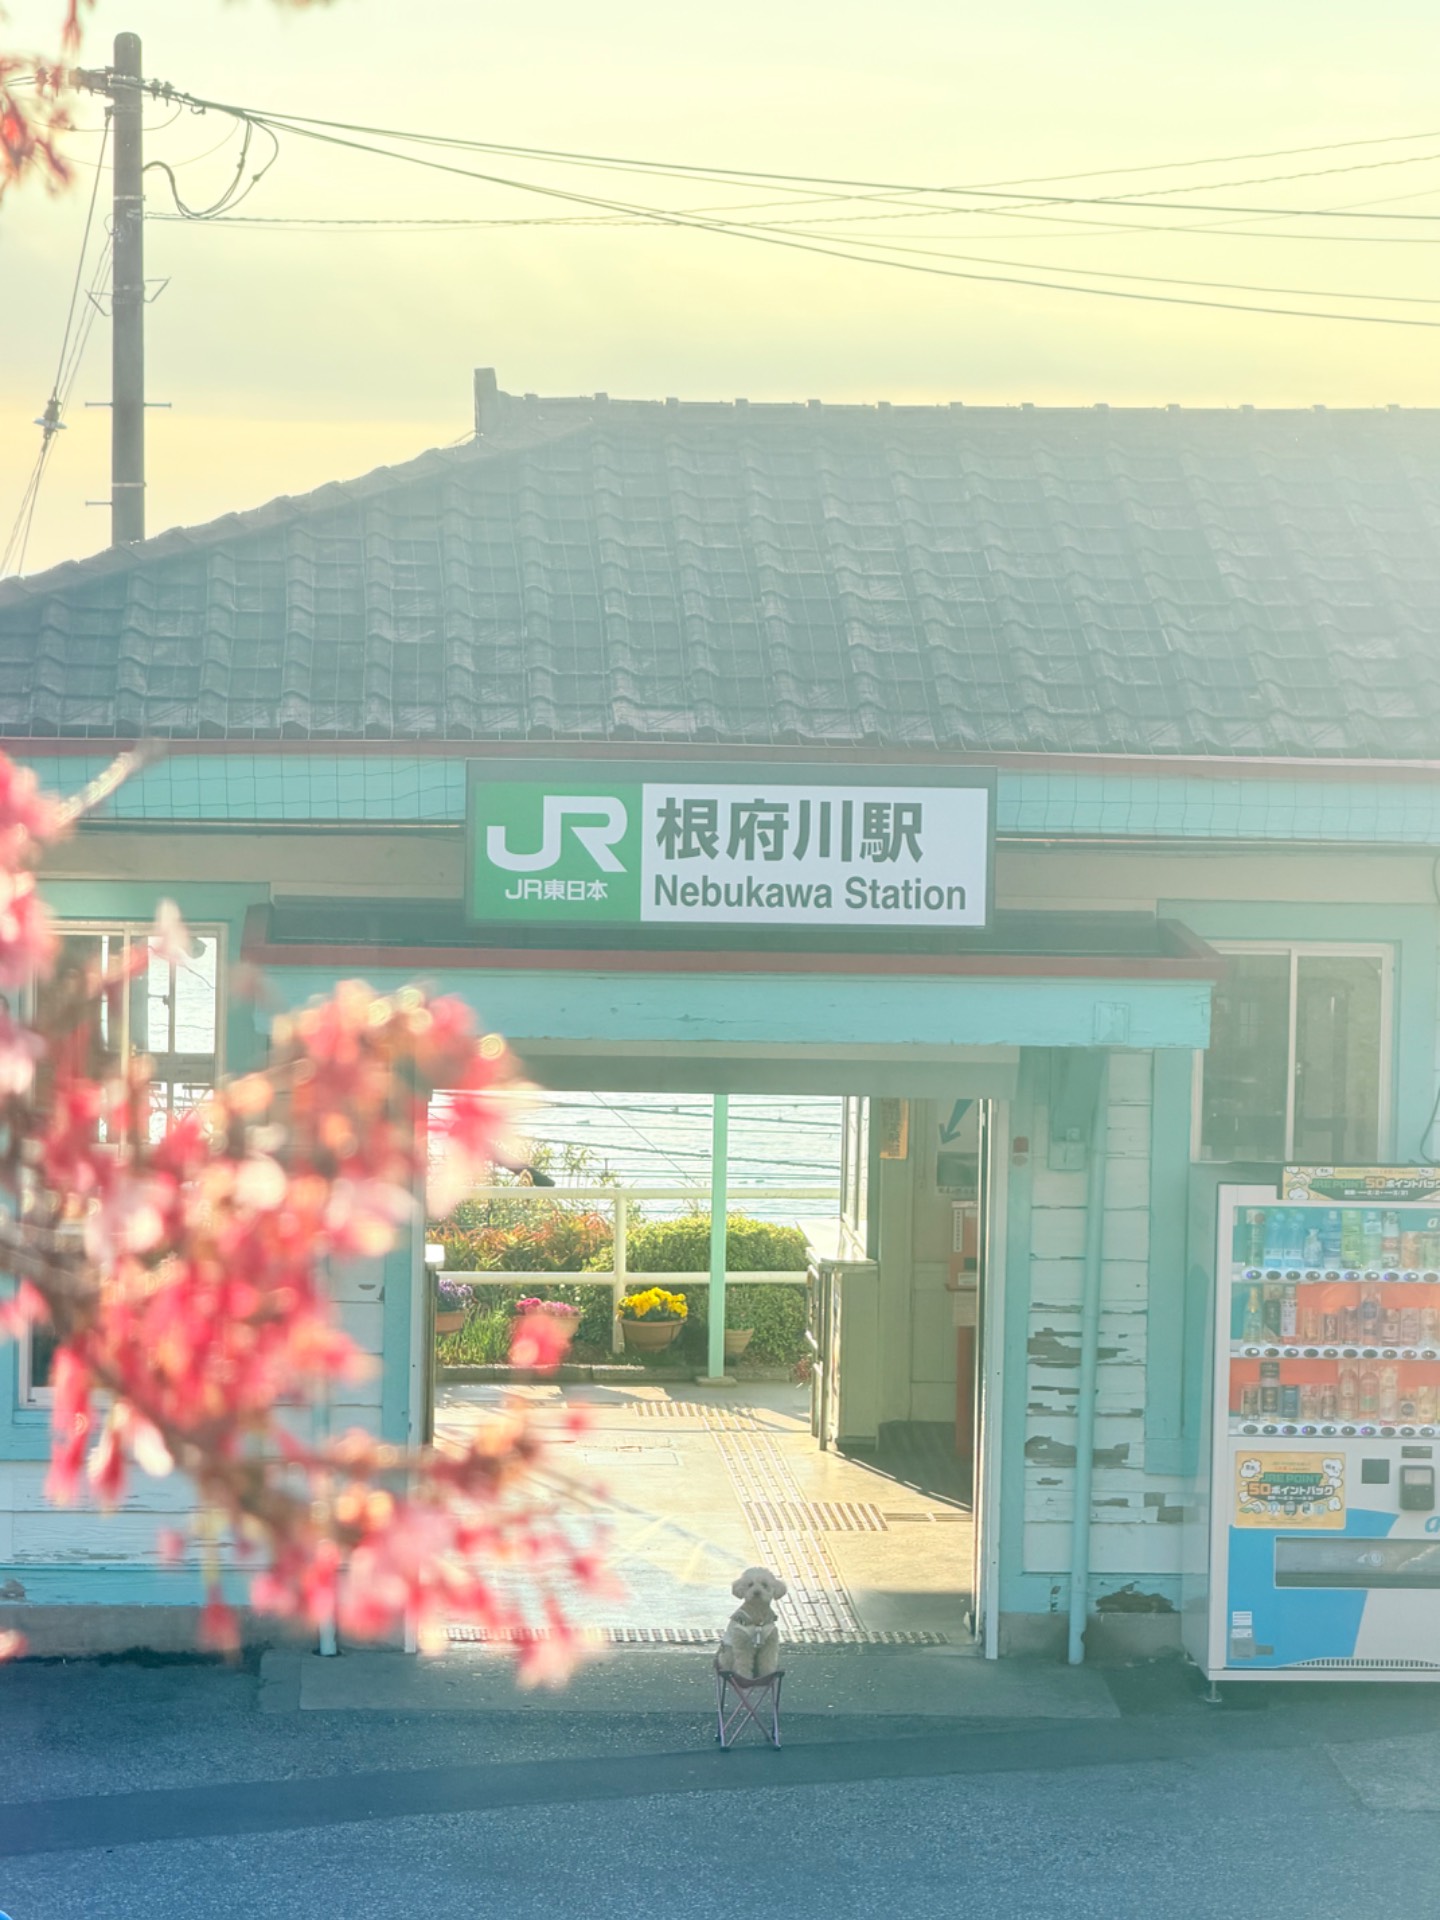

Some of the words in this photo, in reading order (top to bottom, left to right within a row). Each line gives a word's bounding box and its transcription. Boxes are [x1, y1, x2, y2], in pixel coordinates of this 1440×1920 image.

[486, 795, 629, 873] JR
[655, 797, 923, 864] 根府川駅
[504, 878, 609, 902] JR東日本
[653, 874, 833, 910] Nebukawa
[844, 876, 967, 911] Station
